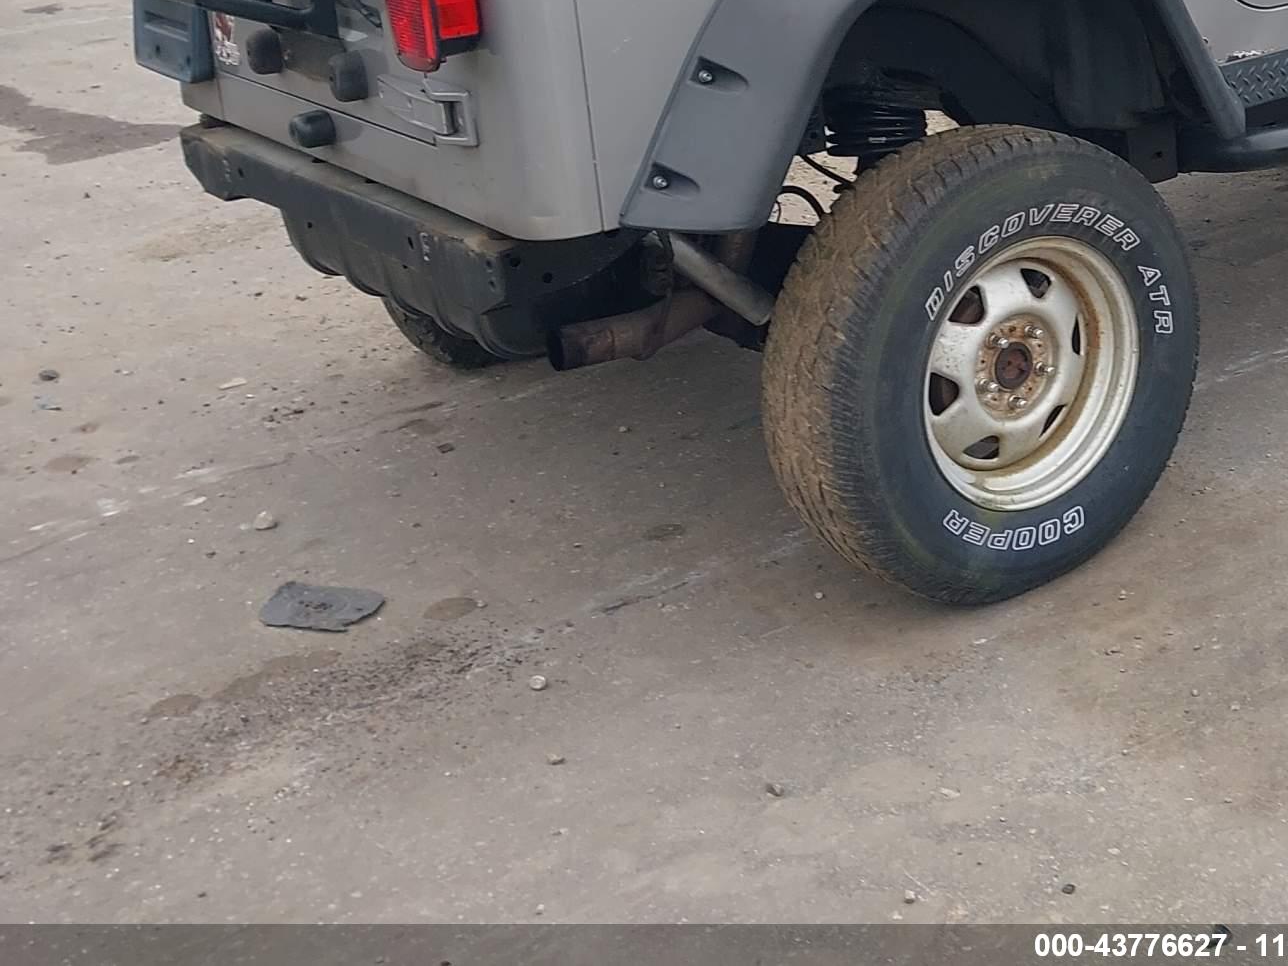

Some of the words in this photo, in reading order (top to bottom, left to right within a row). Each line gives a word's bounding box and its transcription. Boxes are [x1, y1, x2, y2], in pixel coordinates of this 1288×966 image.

[924, 202, 1143, 322] DISCOVERER
[1137, 264, 1175, 335] ATR
[942, 504, 1086, 552] COOPER
